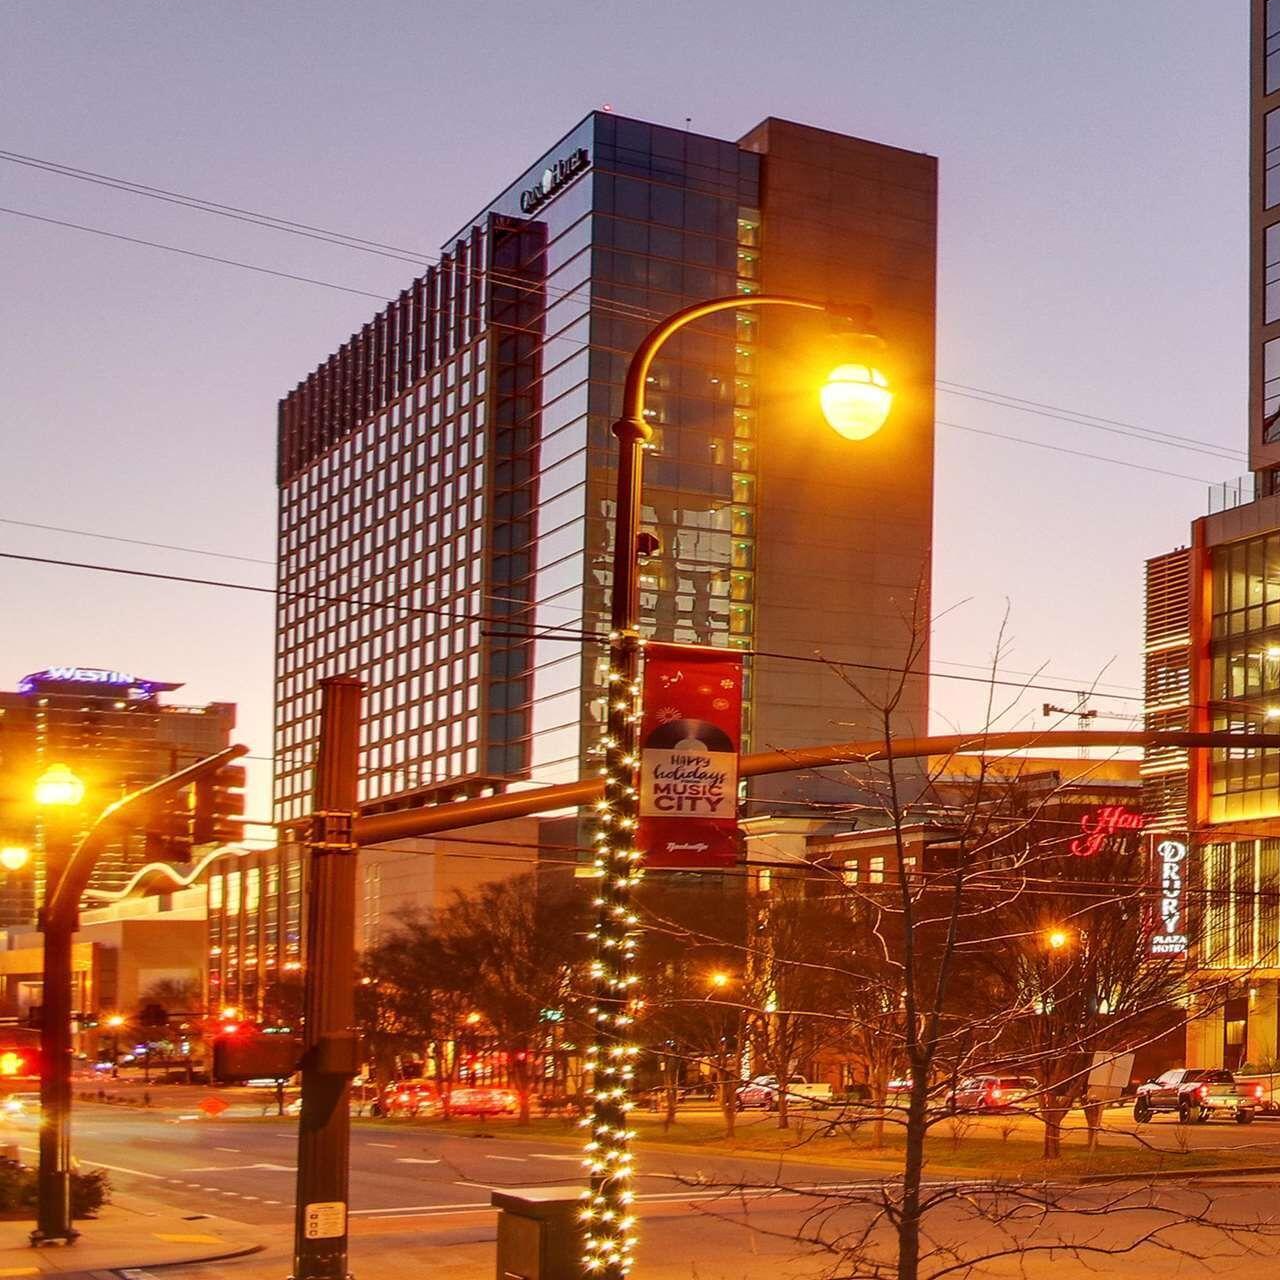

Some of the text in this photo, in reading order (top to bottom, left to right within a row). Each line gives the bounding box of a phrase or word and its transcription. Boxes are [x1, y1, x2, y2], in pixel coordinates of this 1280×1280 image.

[46, 666, 136, 684] WESTIN
[653, 783, 723, 797] MUSIC
[653, 795, 725, 812] CITY
[1157, 840, 1186, 933] DRURY
